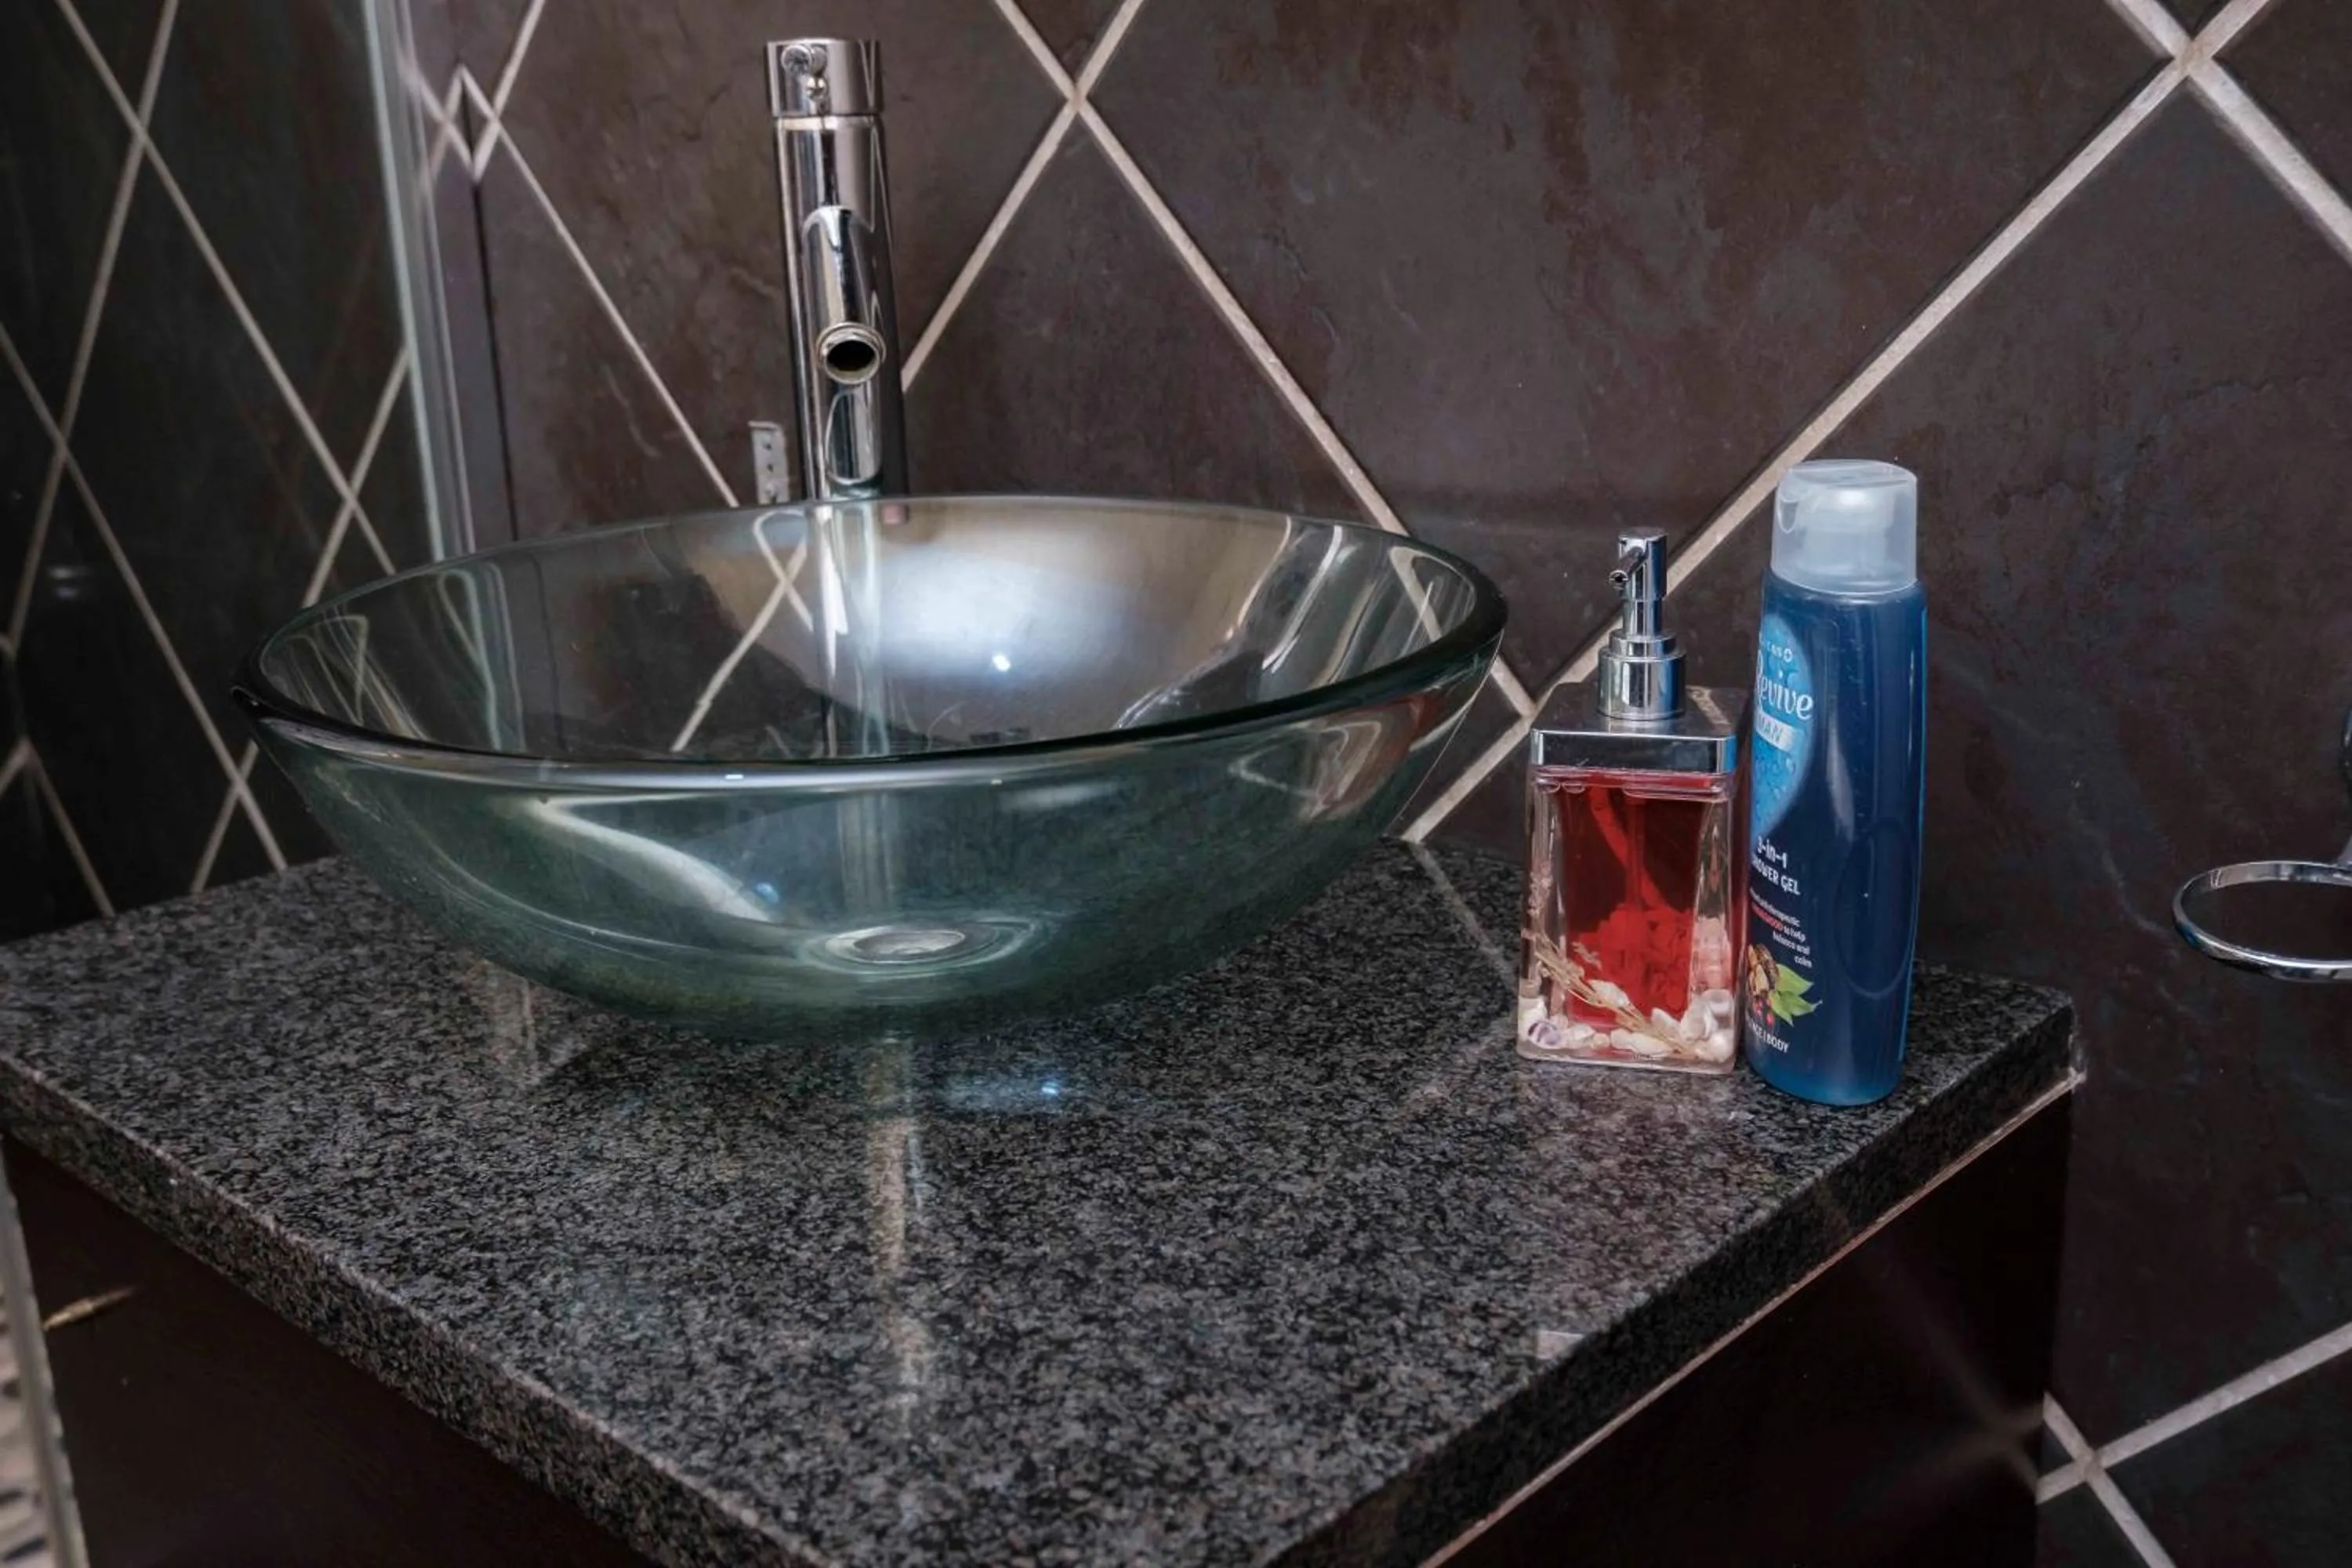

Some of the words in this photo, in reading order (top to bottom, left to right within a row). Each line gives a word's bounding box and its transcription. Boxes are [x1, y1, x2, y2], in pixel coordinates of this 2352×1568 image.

[1756, 649, 1813, 720] Revive
[1751, 853, 1779, 885] OWER
[1781, 875, 1801, 895] GEL
[1767, 1033, 1789, 1053] BODY
